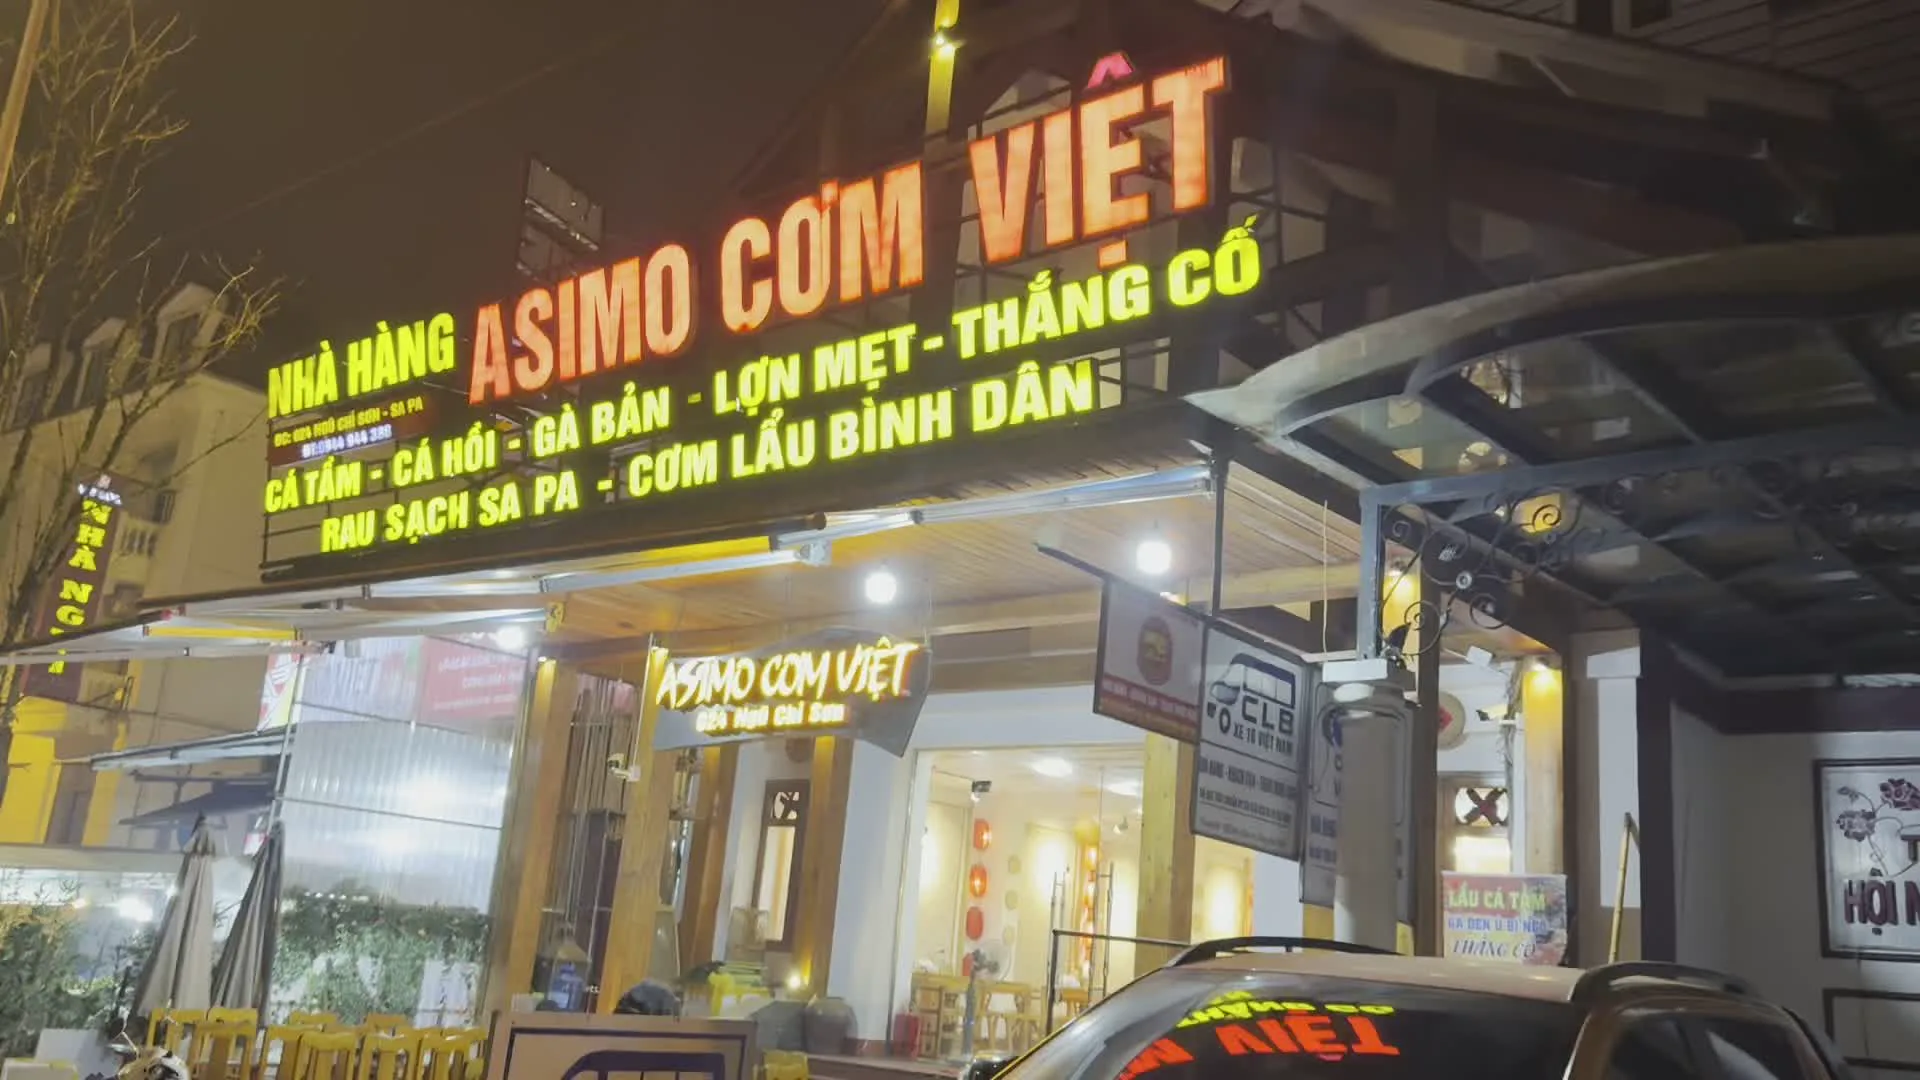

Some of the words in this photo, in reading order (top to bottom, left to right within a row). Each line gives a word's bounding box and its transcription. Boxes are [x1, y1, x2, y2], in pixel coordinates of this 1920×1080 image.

[469, 243, 691, 405] ASIMO
[721, 160, 923, 333] CƠM
[969, 50, 1227, 268] VIỆT
[264, 468, 300, 513] CÁ
[391, 438, 434, 487] CÁ
[533, 402, 580, 457] GÀ
[591, 380, 671, 445] BẢN
[714, 353, 800, 417] LỢN
[814, 324, 917, 390] MẸT
[953, 268, 1151, 360] THẮNG
[1168, 212, 1260, 308] CỐ
[267, 339, 337, 419] NHÀ
[347, 312, 456, 397] HÀNG
[390, 401, 406, 418] SA
[407, 396, 424, 413] PA
[321, 509, 376, 554] RAU
[385, 489, 469, 546] SẠCH
[479, 477, 521, 528] SA
[534, 471, 580, 516] PA
[629, 440, 718, 498] CƠM
[731, 407, 815, 478] LẨU
[829, 381, 952, 460] BÌNH
[972, 359, 1093, 433] DÂN
[655, 655, 756, 709] ASIMO
[837, 636, 920, 702] VIỆT
